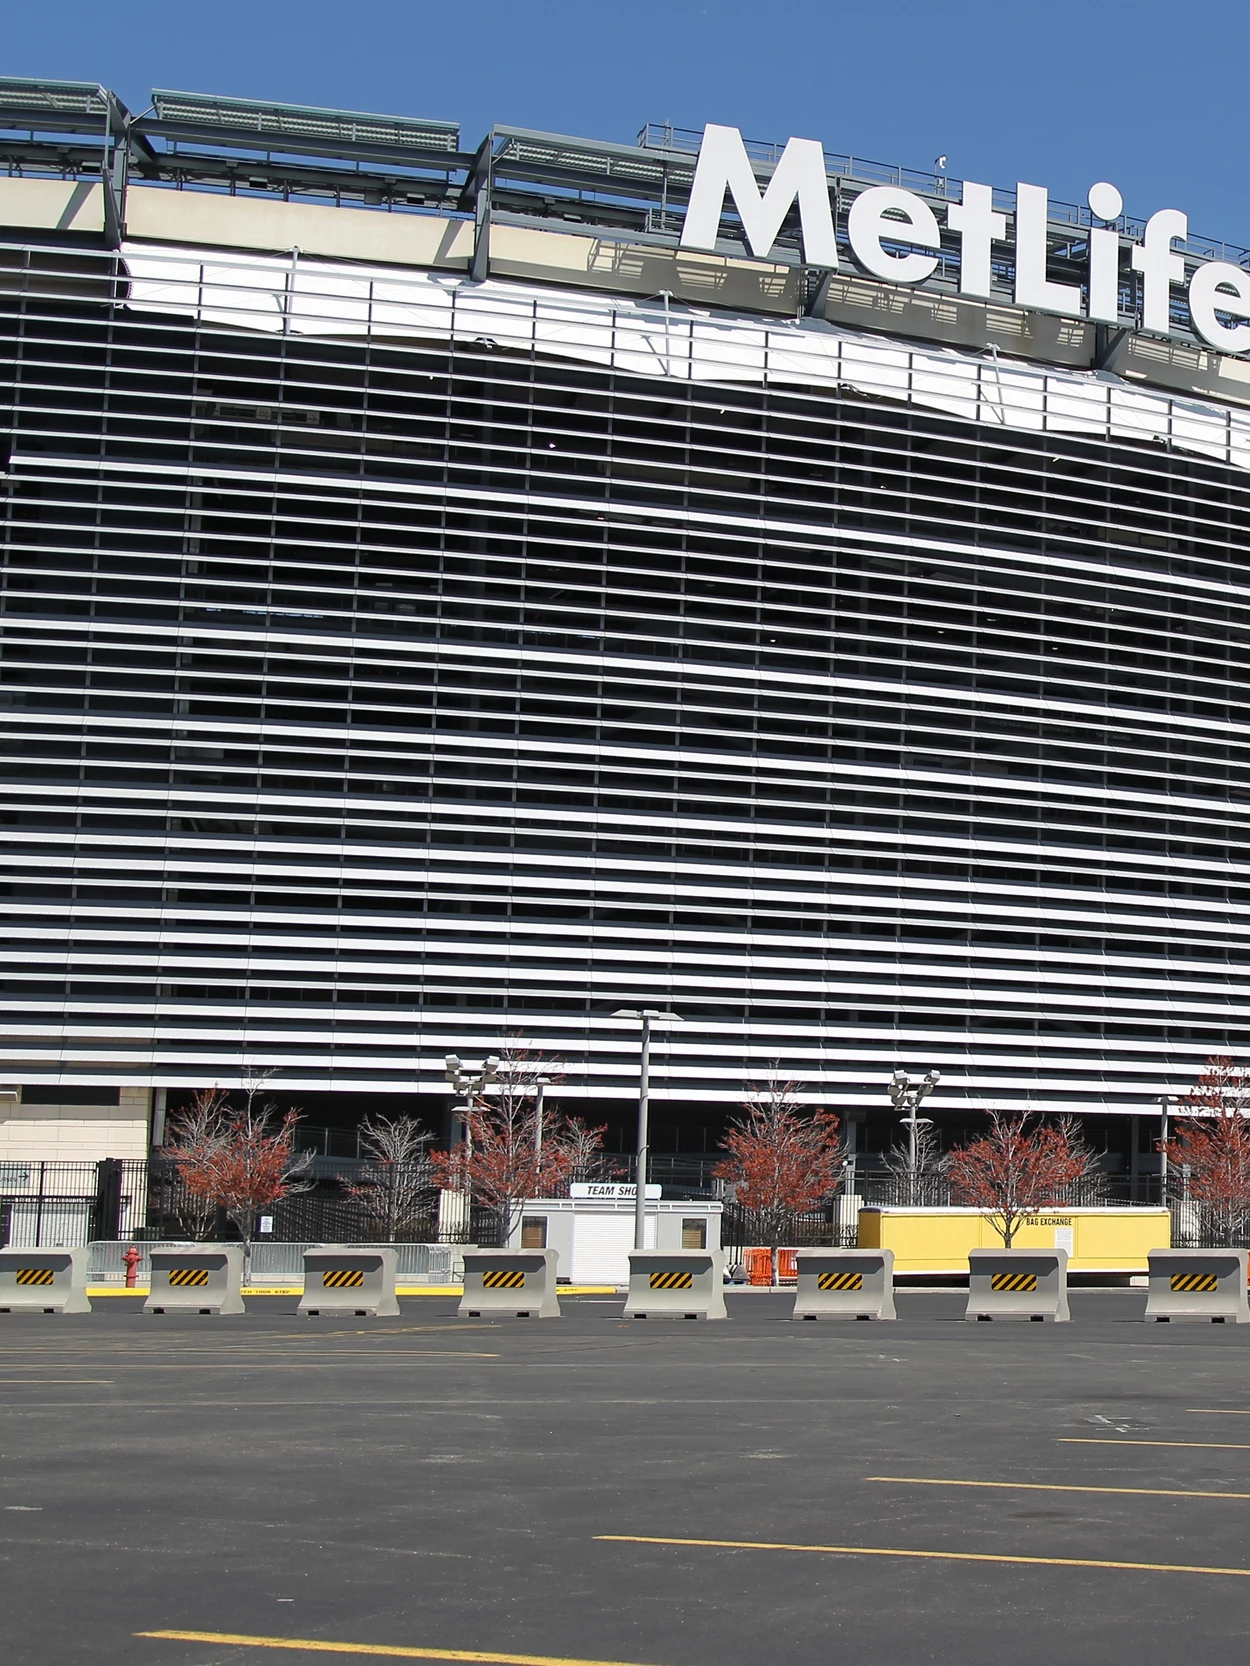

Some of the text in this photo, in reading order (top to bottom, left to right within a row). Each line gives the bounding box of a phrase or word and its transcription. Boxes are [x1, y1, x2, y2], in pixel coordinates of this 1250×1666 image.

[586, 1185, 638, 1196] TEAM SHO
[1026, 1217, 1072, 1226] BAG EXCHANGE
